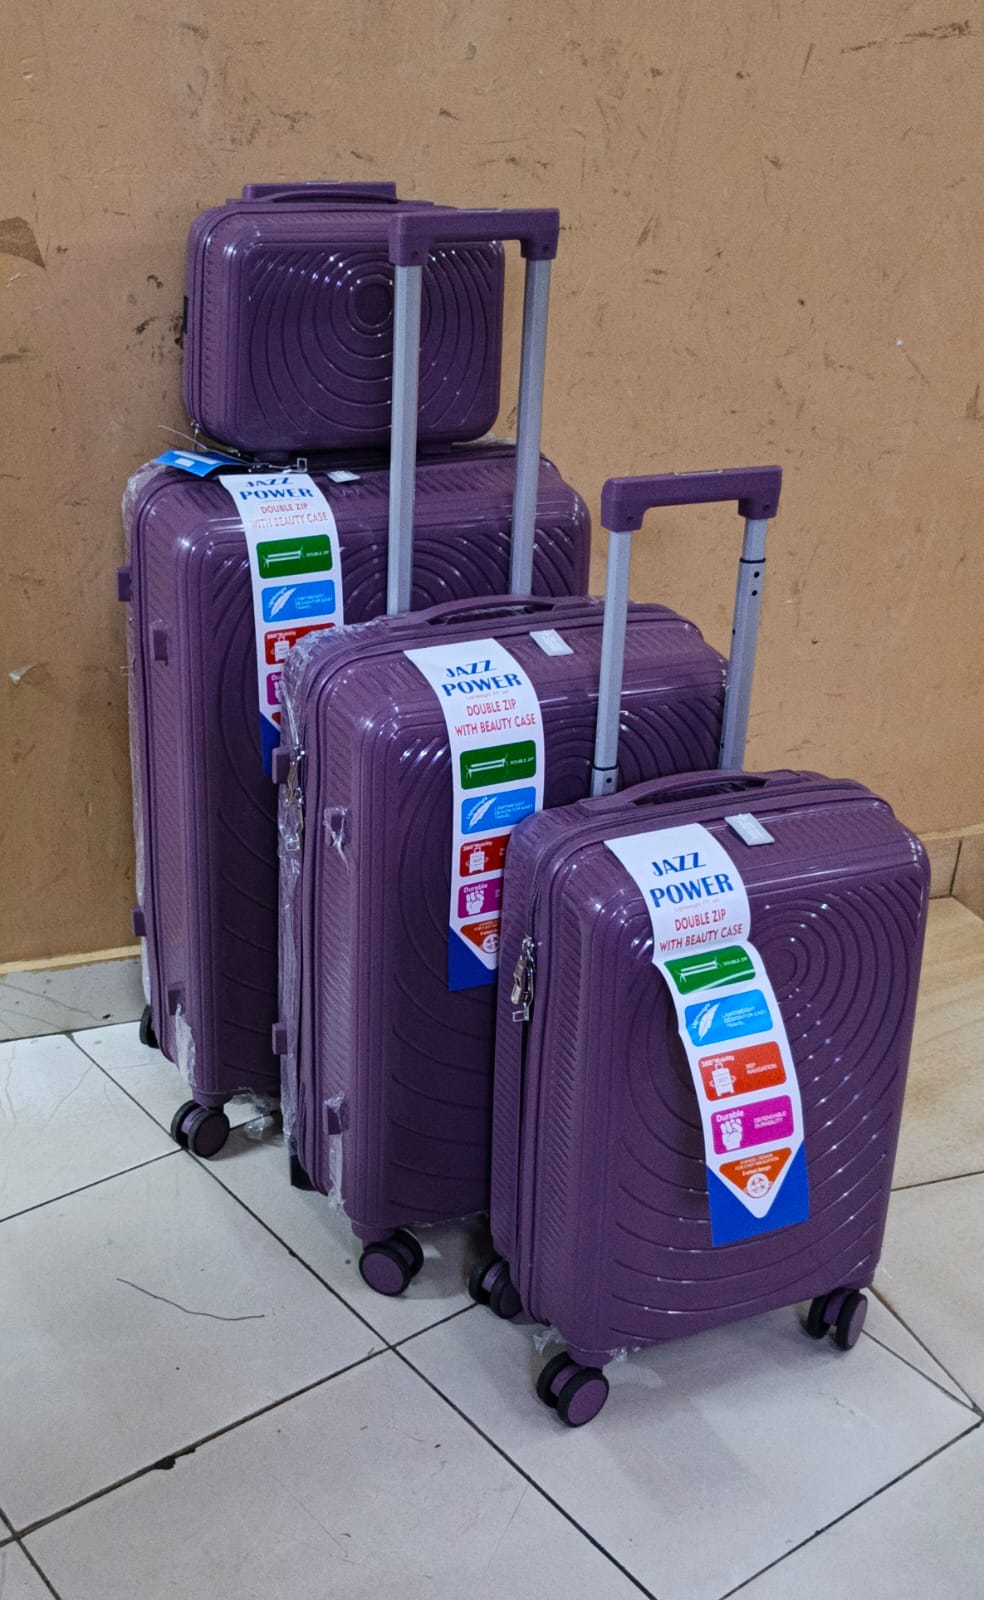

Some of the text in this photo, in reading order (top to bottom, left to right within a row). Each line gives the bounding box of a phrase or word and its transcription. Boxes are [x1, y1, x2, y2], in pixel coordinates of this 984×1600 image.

[246, 477, 294, 487] JAZZ
[240, 488, 314, 500] POWER
[260, 502, 308, 514] DOUBLE ZIP
[273, 514, 305, 527] BEAUTY
[306, 512, 328, 523] CASE
[446, 660, 497, 678] JAZZ
[442, 673, 522, 697] POWER
[466, 698, 516, 717] DOUBLE ZIP
[454, 713, 536, 737] WITH BEAUTY CASE
[651, 851, 707, 877] JAZZ
[649, 873, 734, 908] POWER
[675, 908, 726, 932] DOUBLE ZIP
[659, 923, 743, 952] WITH BEAUTY CASE
[716, 1109, 744, 1123] Durable
